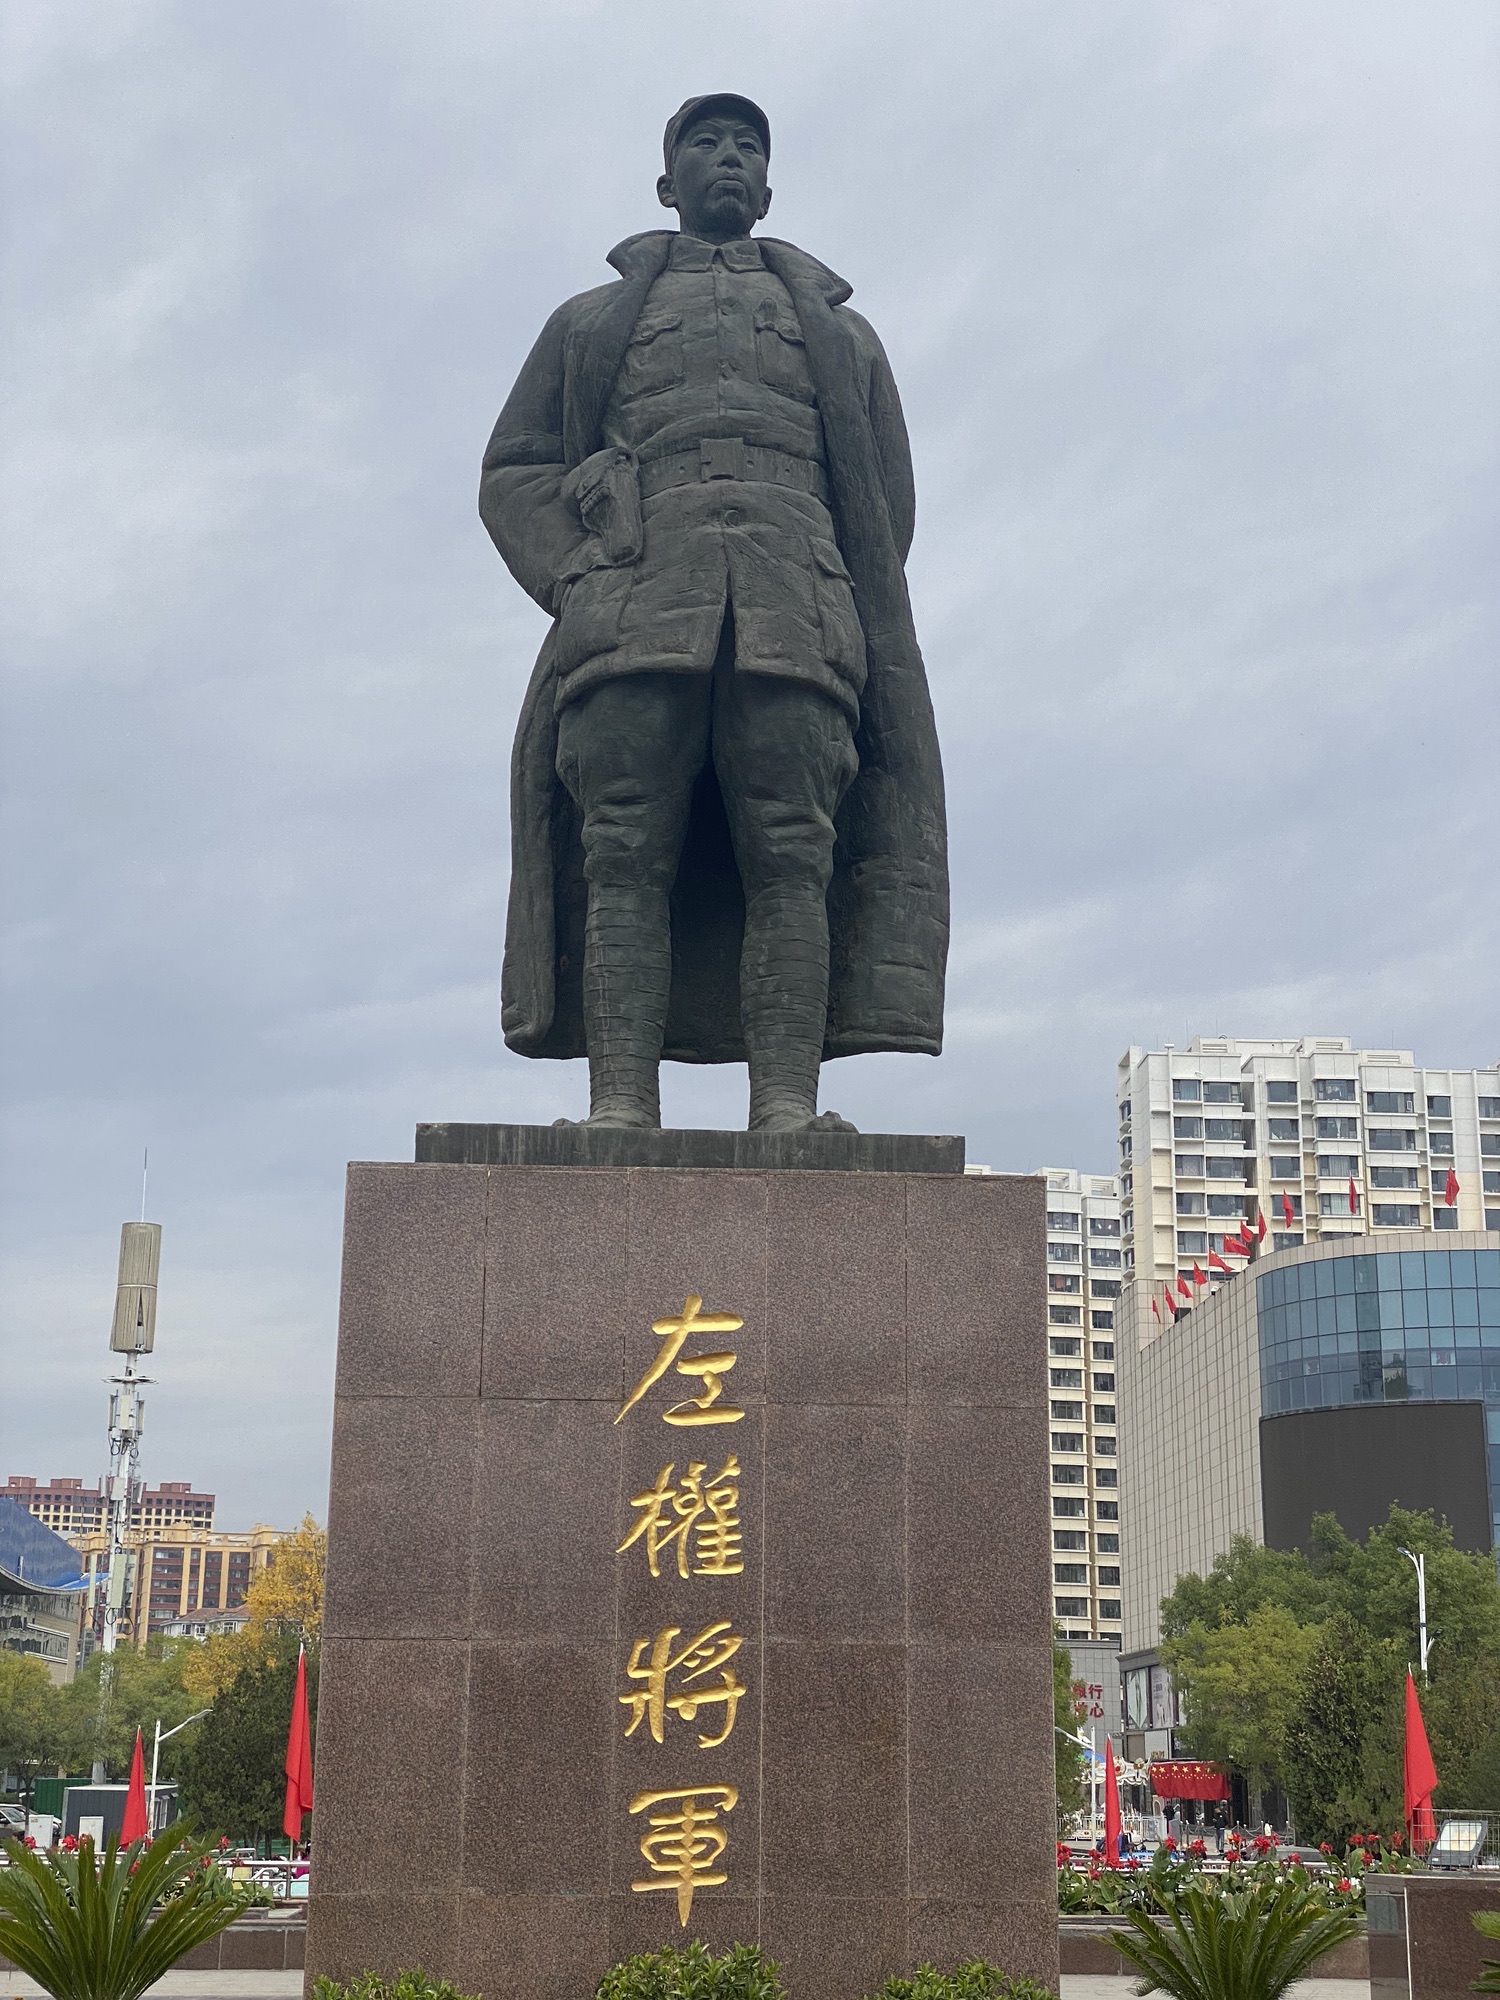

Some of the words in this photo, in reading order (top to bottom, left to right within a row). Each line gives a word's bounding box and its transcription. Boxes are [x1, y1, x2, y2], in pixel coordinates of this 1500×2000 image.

[614, 1294, 746, 1926] 左權將軍
[1074, 1701, 1104, 1718] 心
